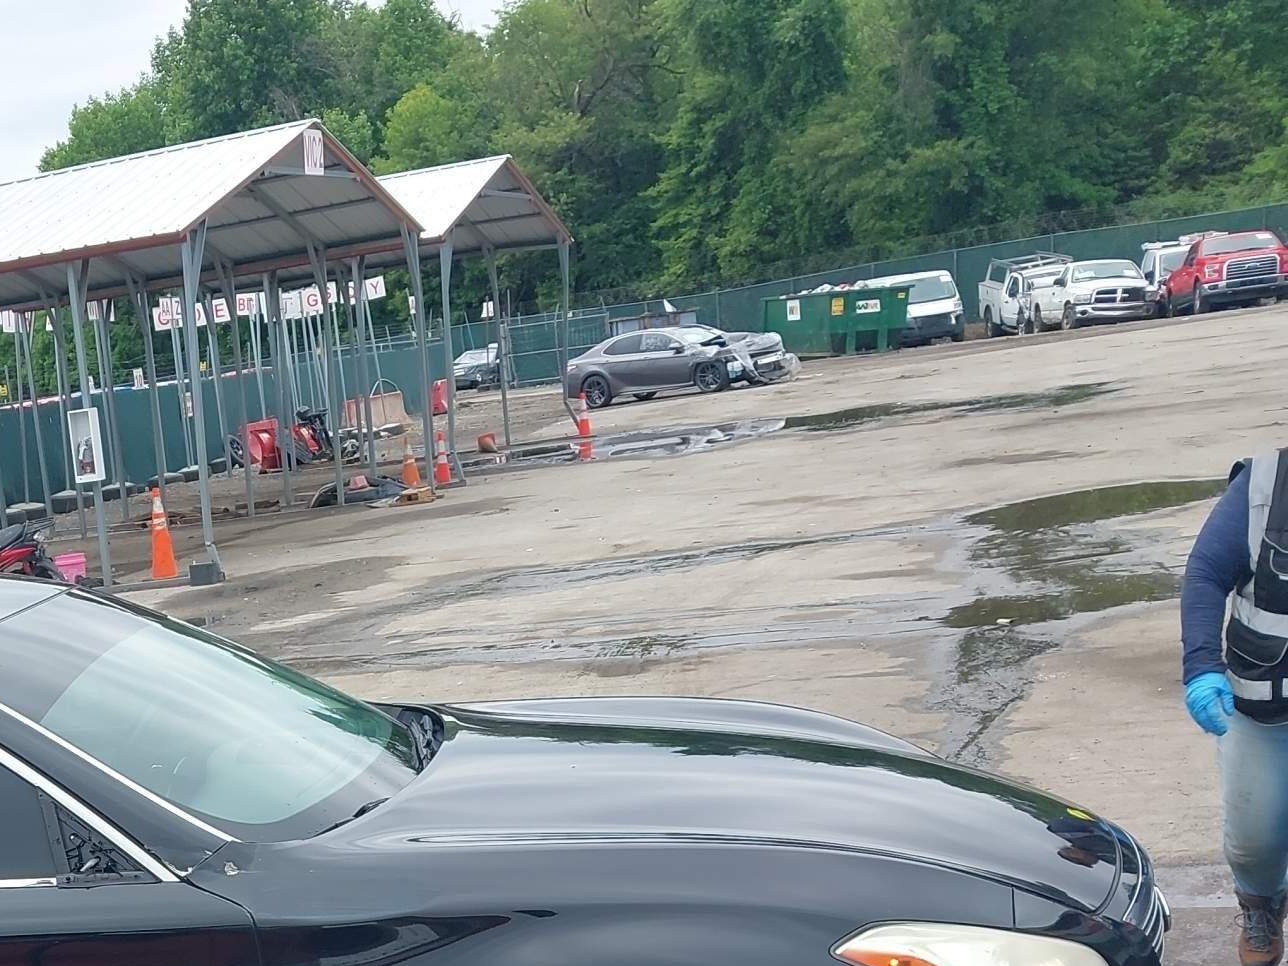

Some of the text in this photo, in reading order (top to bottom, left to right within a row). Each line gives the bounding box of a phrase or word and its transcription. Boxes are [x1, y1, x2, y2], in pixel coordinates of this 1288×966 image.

[371, 281, 380, 295] Y
[307, 294, 318, 308] G
[215, 303, 225, 318] E
